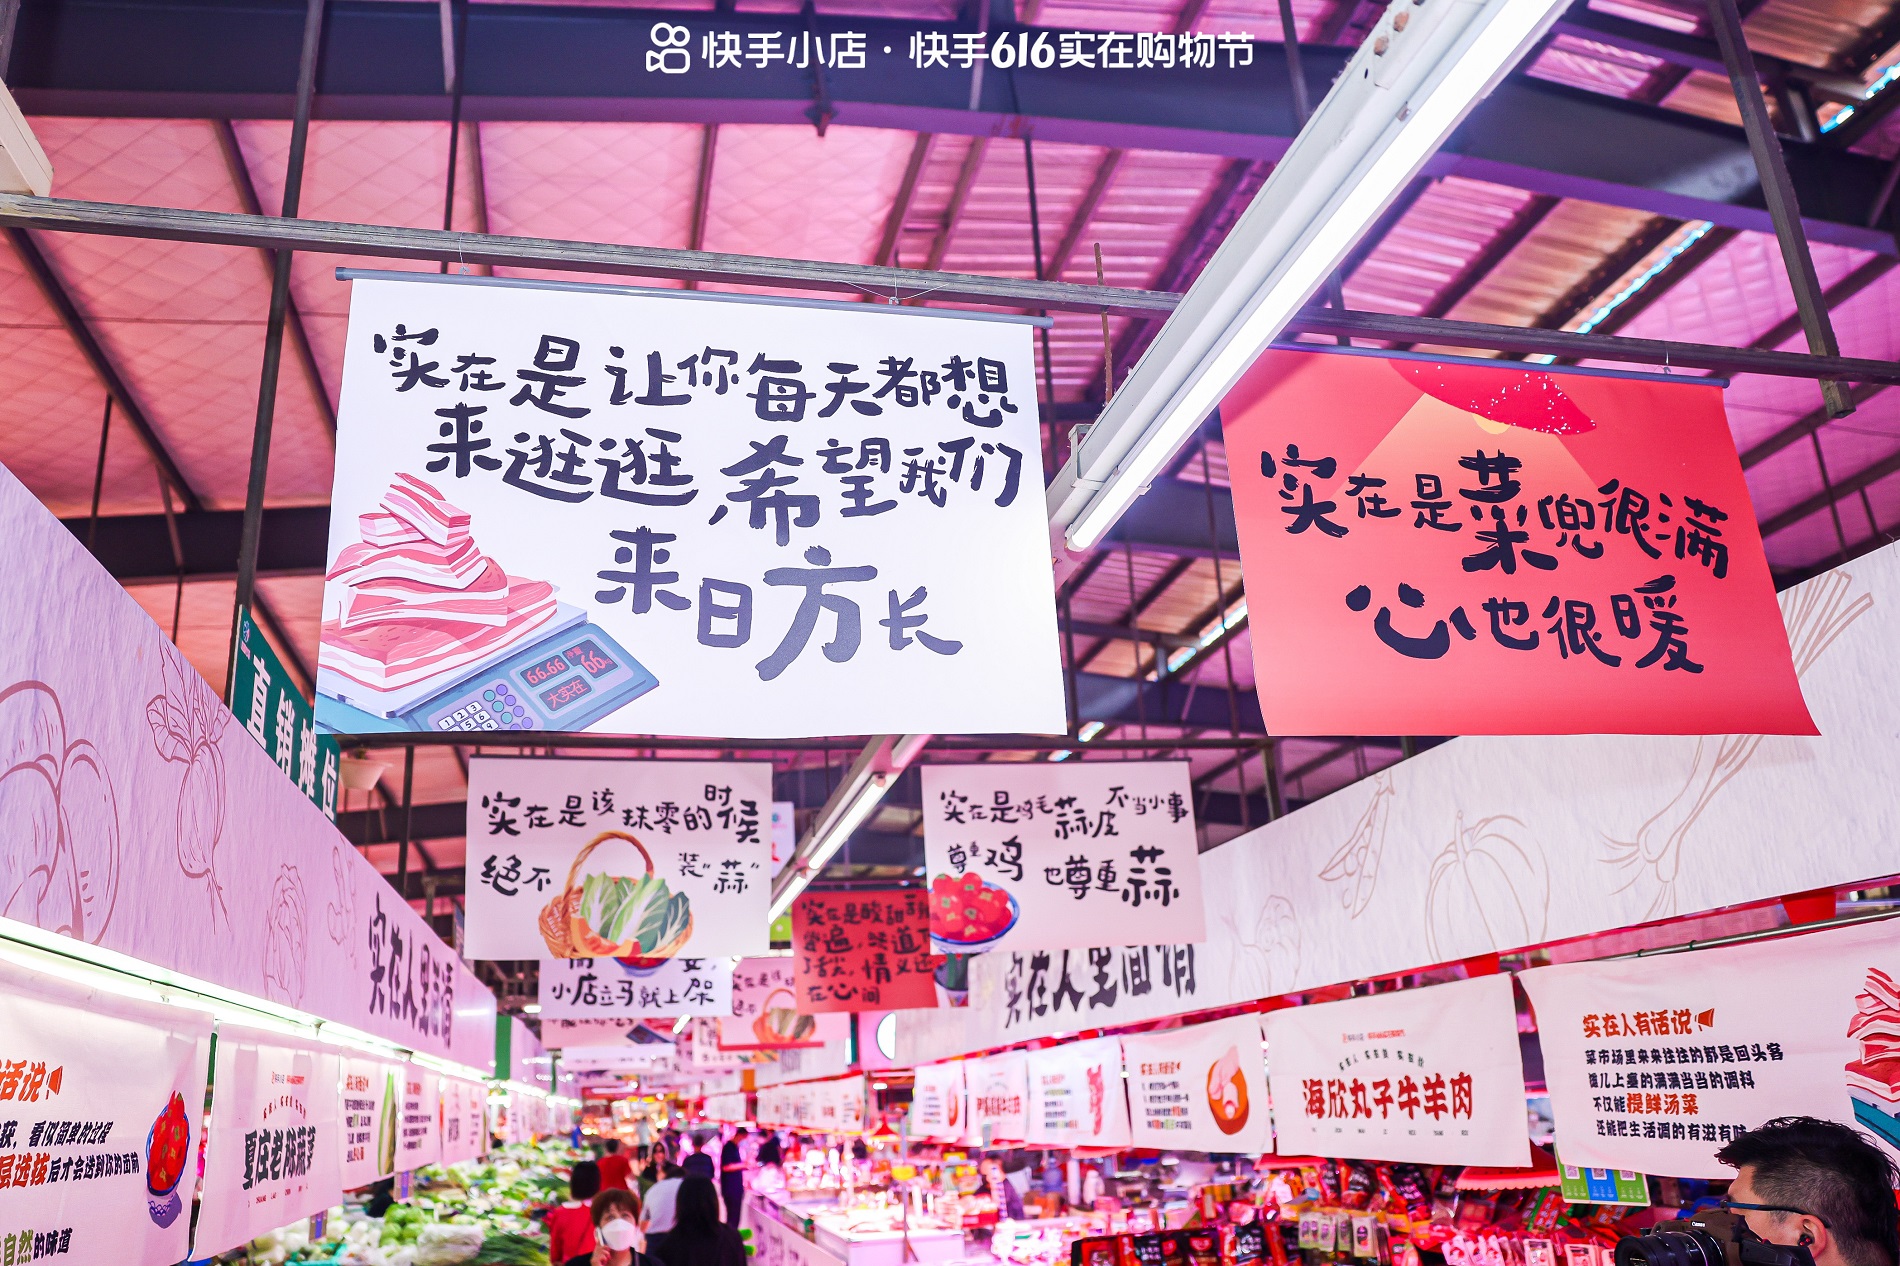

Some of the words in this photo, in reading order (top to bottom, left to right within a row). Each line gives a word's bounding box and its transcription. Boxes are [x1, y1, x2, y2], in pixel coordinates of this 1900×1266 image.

[374, 324, 1018, 428] 实在是让你每天都想
[1261, 443, 1729, 579] 实在是菜兜很满
[595, 526, 963, 681] 来日方长
[1345, 574, 1704, 673] 心也很暖
[526, 659, 566, 684] 66.66
[548, 679, 588, 708] 大实在
[246, 655, 337, 821] 直销摊位
[482, 784, 760, 843] 实在是该抹零的时候
[481, 855, 551, 896] 绝不
[1044, 845, 1180, 907] 也尊重蒜
[552, 973, 714, 1008] 小店立马就上架
[1582, 1008, 1693, 1039] 实在人有话说
[1585, 1042, 1784, 1065] 菜市场里来来往往的都是回头客
[1302, 1072, 1473, 1121] 海欣丸子牛羊肉
[1593, 1092, 1699, 1115] 不仅能提鲜汤菜
